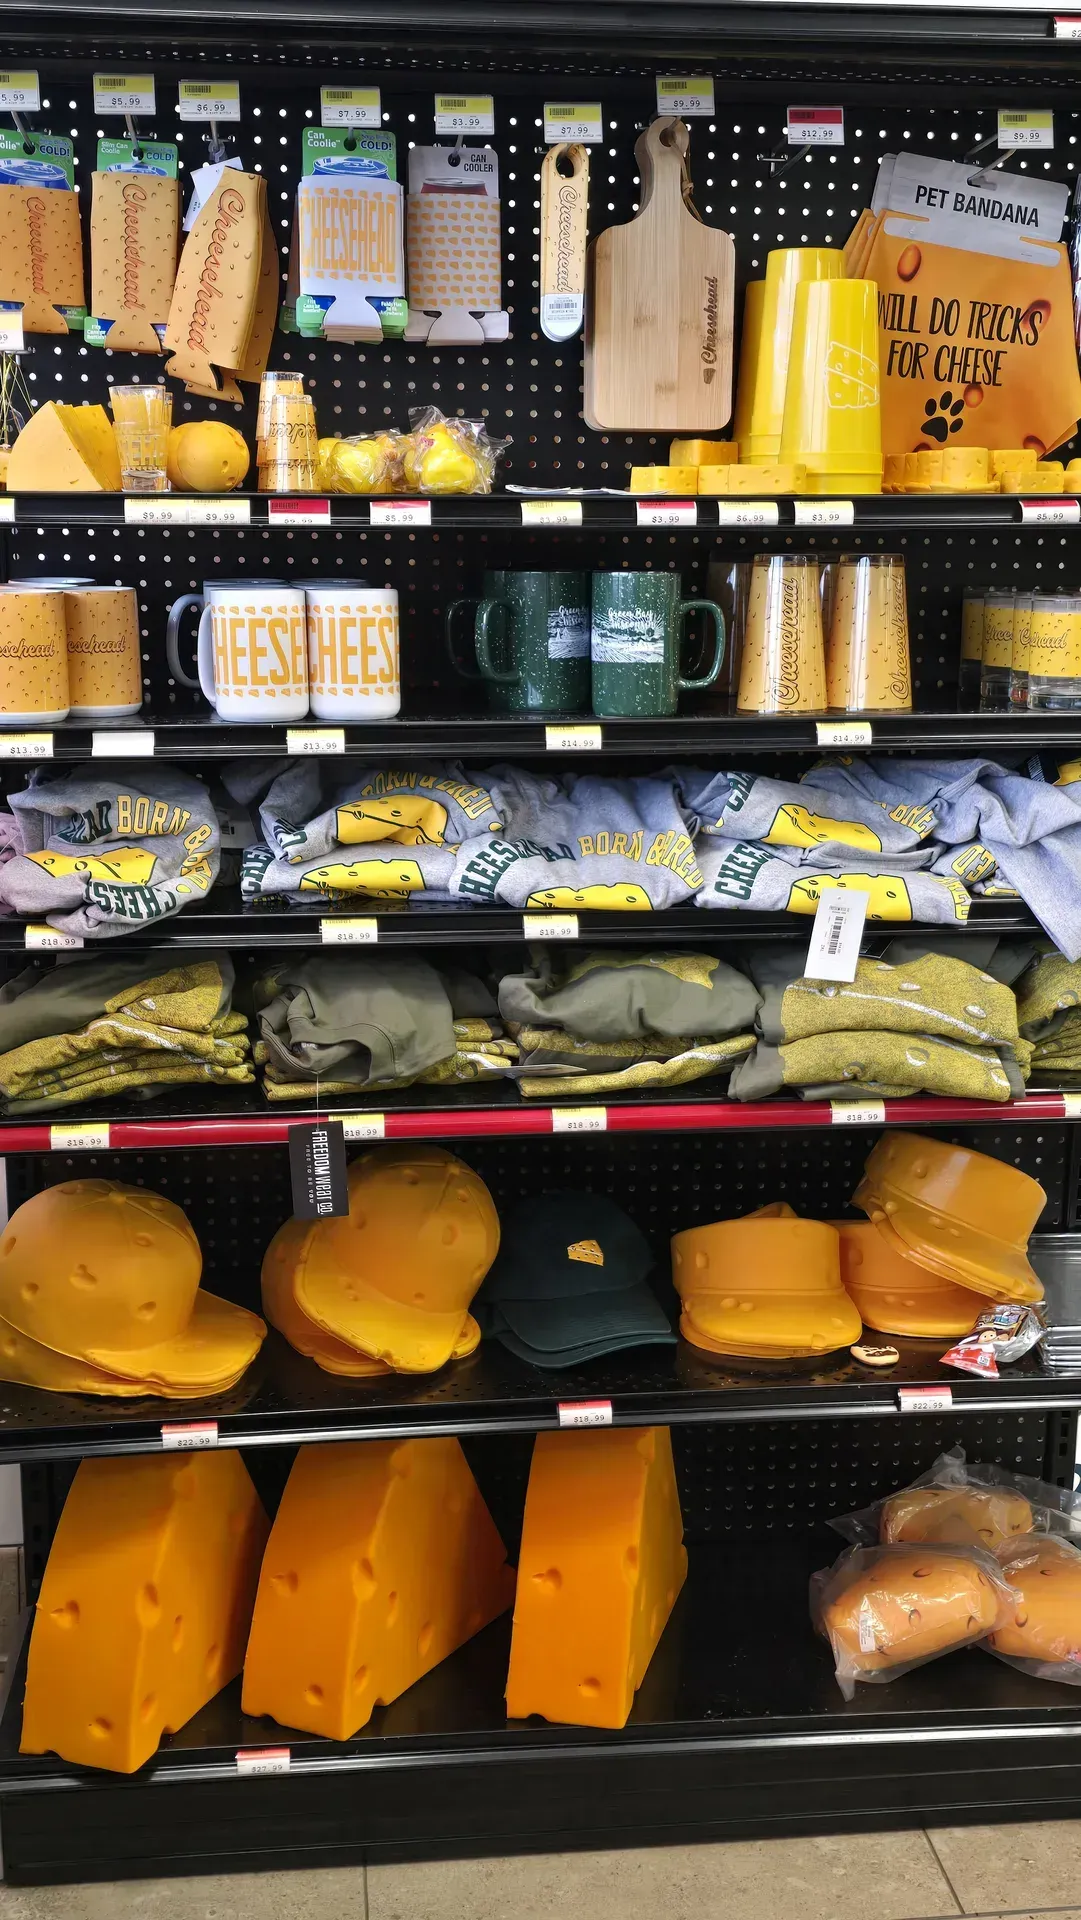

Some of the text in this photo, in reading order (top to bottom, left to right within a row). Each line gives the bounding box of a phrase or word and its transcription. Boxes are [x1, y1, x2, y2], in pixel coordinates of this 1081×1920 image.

[111, 97, 141, 106] $5.99
[673, 100, 701, 108] $9.99
[196, 104, 226, 112] $6.99
[338, 110, 366, 118] $7.99
[452, 118, 480, 126] $3.99
[307, 130, 325, 139] Can
[561, 126, 589, 135] $7.99
[801, 130, 834, 138] $12.99
[1013, 132, 1040, 140] $9.99
[360, 140, 392, 151] COLD!
[40, 145, 70, 156] COLD!
[146, 152, 174, 161] COLD!
[470, 154, 487, 163] CAN
[463, 162, 494, 173] COOLER
[915, 185, 1039, 228] PET BANDANA
[299, 194, 396, 275] CHEESEHEAD
[557, 185, 578, 292] Cheesehead
[26, 196, 50, 296] Cheesehead
[122, 182, 148, 311] Cheesehead
[187, 188, 246, 355] Cheesehead
[700, 276, 718, 365] Cheesehead
[929, 297, 961, 337] DO
[967, 300, 1043, 347] TRICKS
[886, 339, 1008, 387] FOR CHEESE
[142, 511, 173, 520] $9.99
[205, 513, 235, 521] $9.99
[385, 514, 414, 522] $5.99
[539, 515, 568, 524] $3.99
[651, 515, 680, 524] $3.99
[812, 513, 840, 521] $3.99
[1036, 512, 1064, 521] $5.99
[771, 576, 799, 706] Cheesehead
[832, 734, 865, 743] $14.99
[302, 741, 338, 750] $13.99
[561, 739, 594, 748] $14.99
[10, 746, 46, 755] $13.99
[117, 794, 191, 837] BORN
[578, 830, 645, 862] BORN
[538, 927, 572, 936] $18.99
[337, 932, 371, 941] $18.99
[41, 937, 76, 946] $18.99
[846, 1113, 878, 1121] $18.99
[567, 1120, 600, 1129] $18.99
[344, 1128, 378, 1138] $18.99
[66, 1138, 102, 1147] $18.99
[312, 1130, 331, 1175] FREEDOM
[912, 1402, 944, 1411] $22.99
[573, 1414, 605, 1423] $18.99
[177, 1437, 211, 1447] $22.99
[251, 1764, 283, 1773] $27.99
